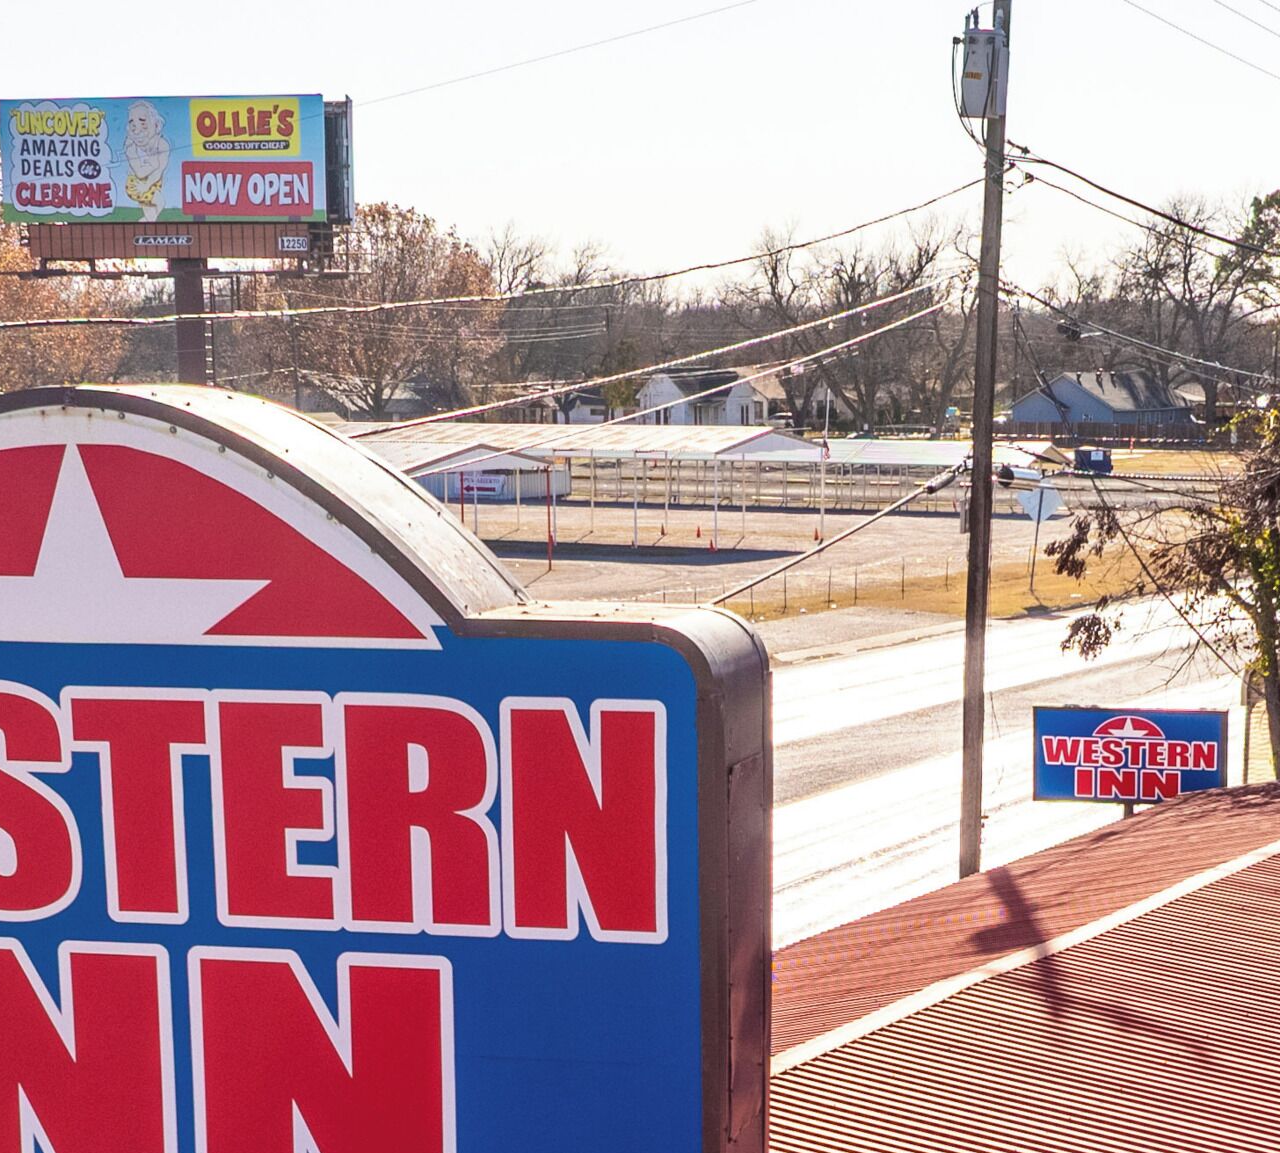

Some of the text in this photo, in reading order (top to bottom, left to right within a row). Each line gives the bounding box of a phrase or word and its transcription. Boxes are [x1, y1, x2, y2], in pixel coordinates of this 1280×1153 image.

[20, 139, 101, 157] AMAZING
[21, 158, 75, 177] DEALS
[16, 181, 113, 208] CLEBURNE
[185, 172, 310, 206] NOW OPEN
[137, 237, 189, 245] LAMAR
[281, 238, 307, 249] 12250
[1042, 735, 1218, 772] WESTERN
[1075, 767, 1181, 800] INN
